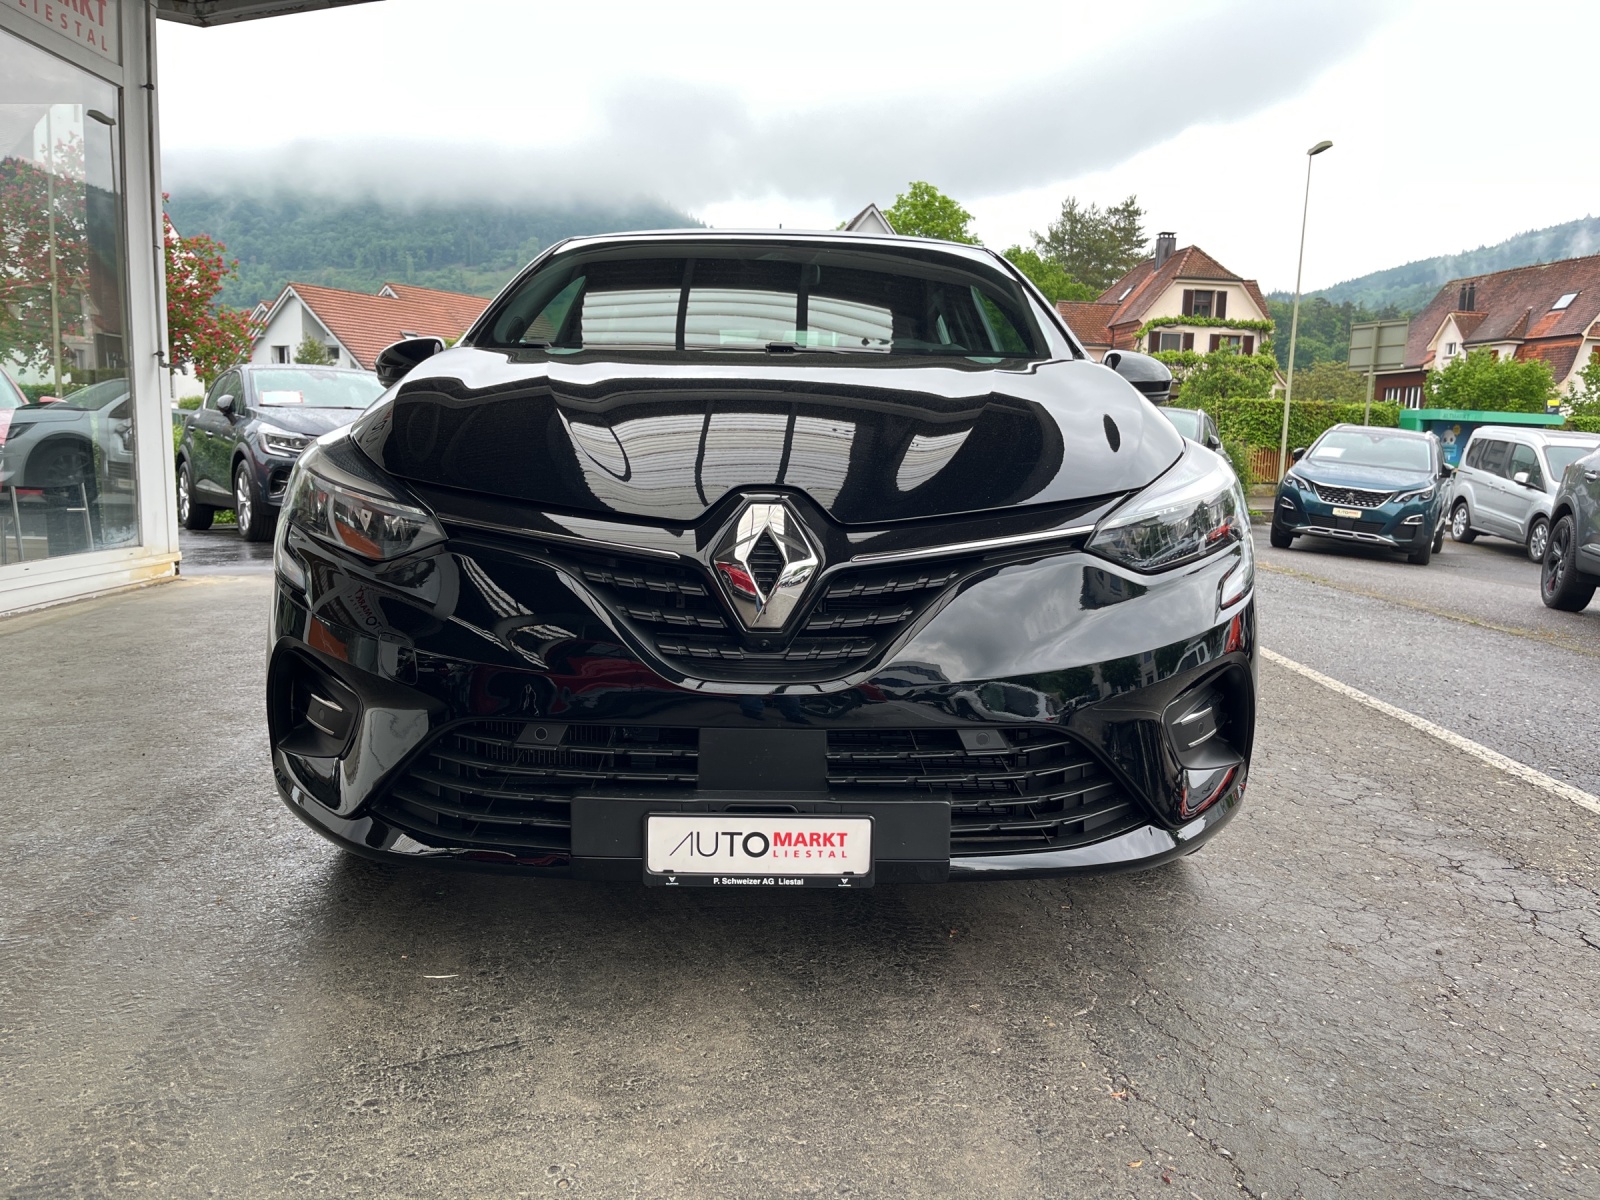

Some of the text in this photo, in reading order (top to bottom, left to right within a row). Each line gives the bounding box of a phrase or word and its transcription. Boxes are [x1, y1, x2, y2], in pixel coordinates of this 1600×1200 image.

[669, 831, 848, 858] AUTO MARKT
[773, 850, 848, 858] LIESTAL
[713, 877, 804, 886] P. Schweizer AG Liestal
